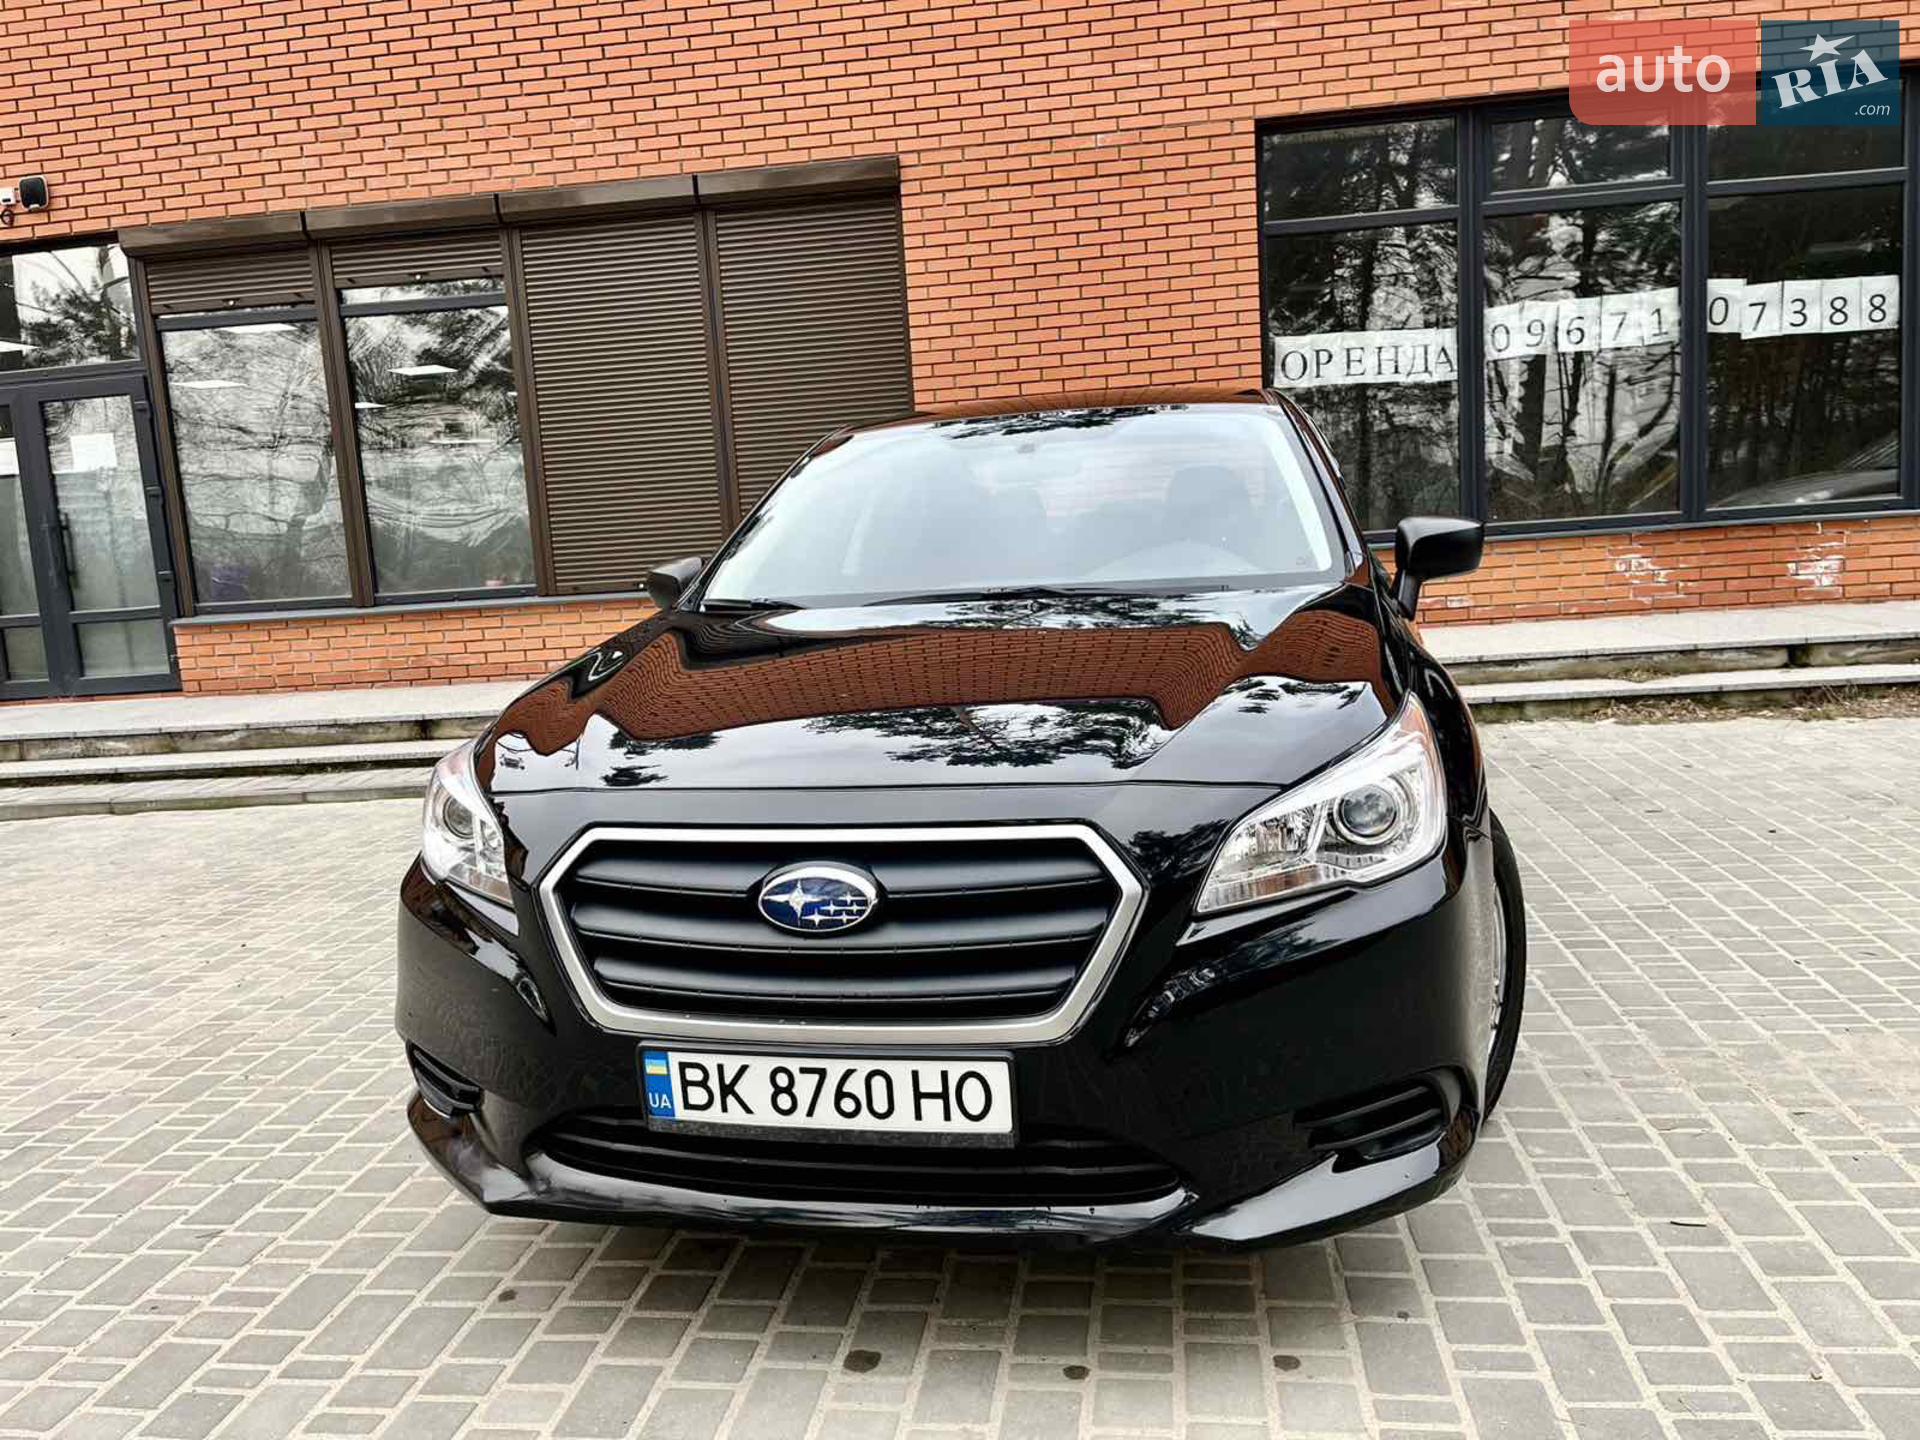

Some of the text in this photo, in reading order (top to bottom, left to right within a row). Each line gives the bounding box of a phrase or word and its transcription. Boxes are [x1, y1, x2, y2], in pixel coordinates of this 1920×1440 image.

[1280, 293, 1888, 382] ОРЕНДА 09671 07388
[648, 1092, 672, 1109] UA
[678, 1061, 993, 1122] BK 8760 HO
